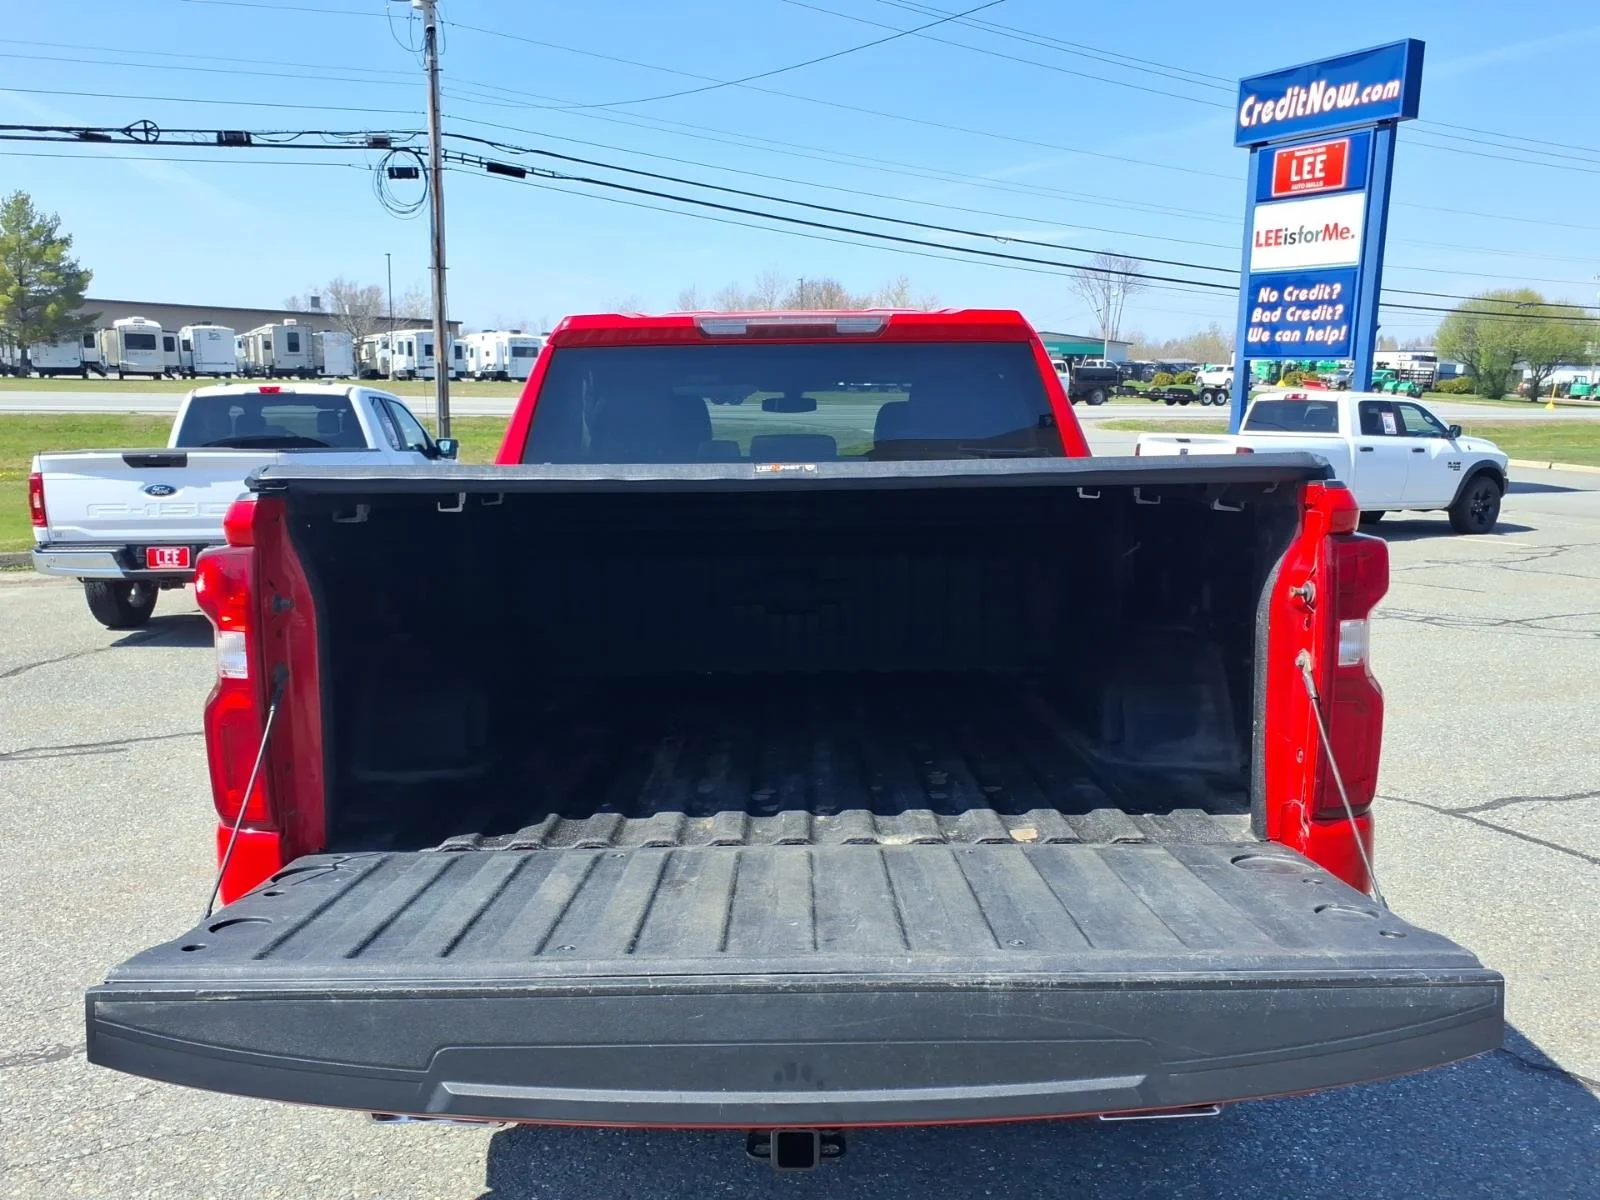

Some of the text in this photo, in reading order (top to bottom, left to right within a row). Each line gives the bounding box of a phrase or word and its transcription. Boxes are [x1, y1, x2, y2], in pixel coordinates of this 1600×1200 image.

[1239, 79, 1400, 126] CreditNow.com
[1290, 154, 1327, 182] LEE
[1255, 222, 1355, 248] LEEisforMe.
[1257, 283, 1341, 303] No Credit?
[1251, 304, 1343, 322] Bad Credit?
[1247, 325, 1347, 345] We can help!
[156, 550, 180, 564] LEE
